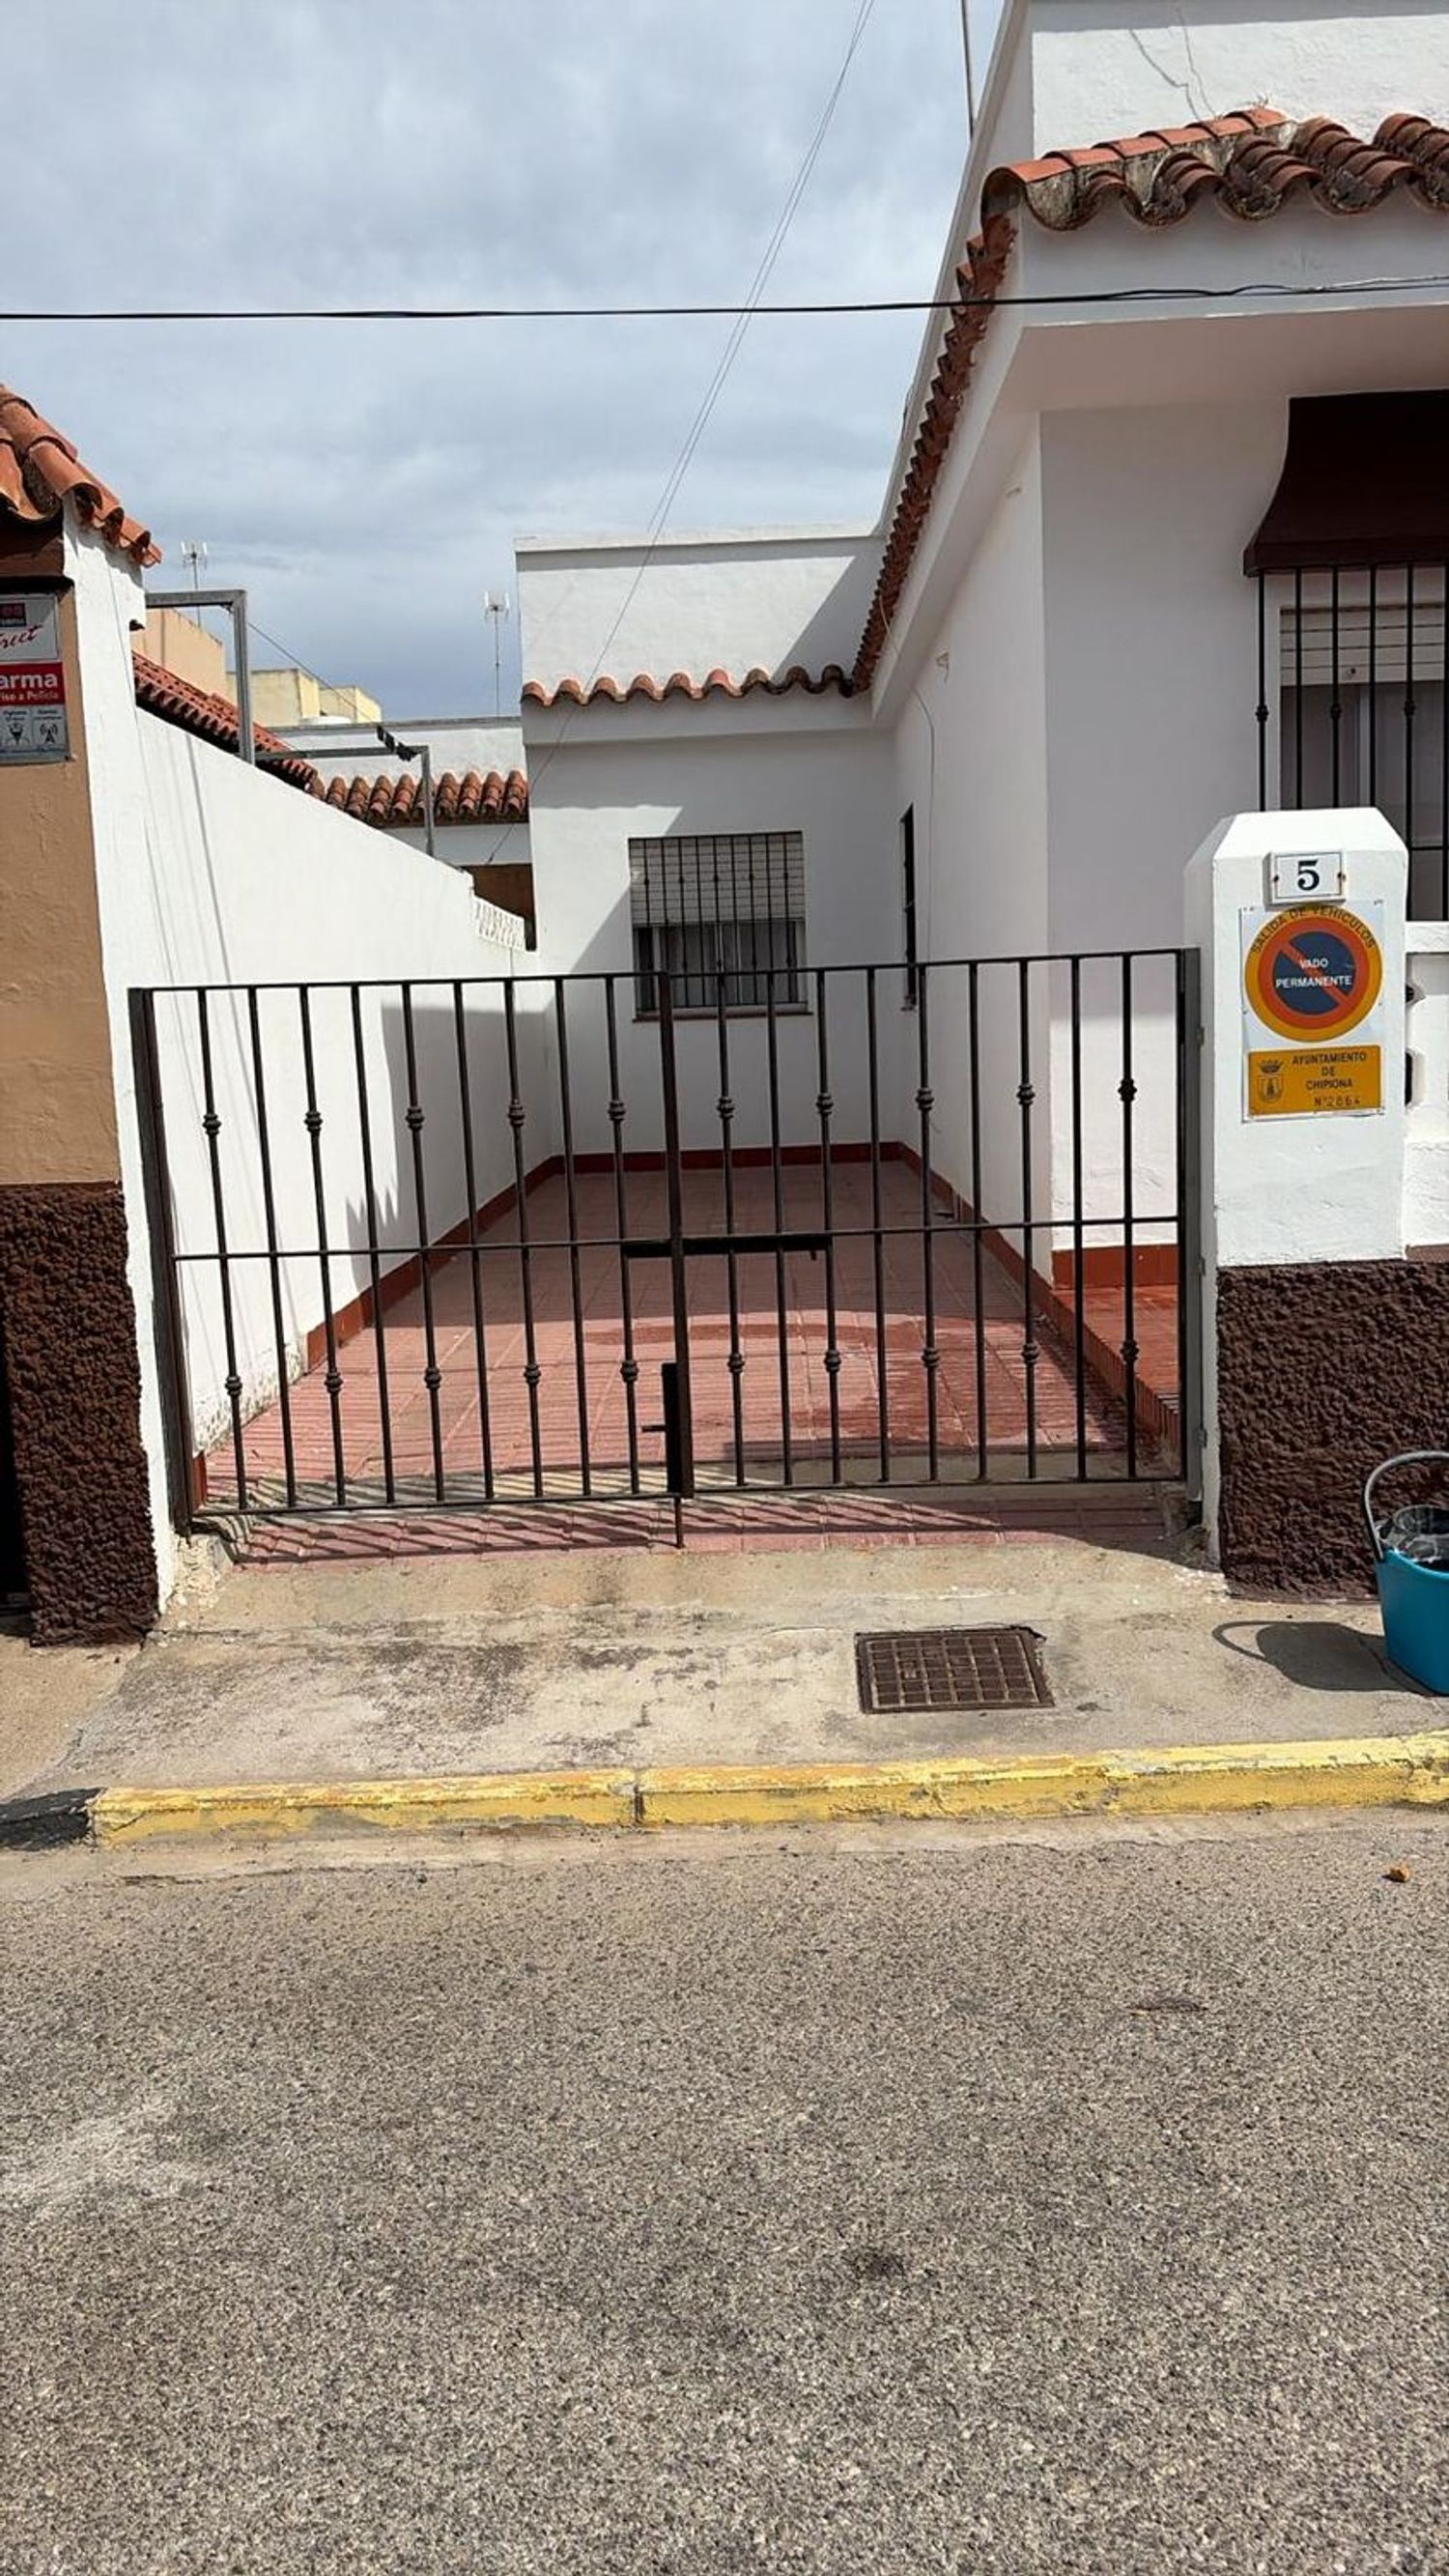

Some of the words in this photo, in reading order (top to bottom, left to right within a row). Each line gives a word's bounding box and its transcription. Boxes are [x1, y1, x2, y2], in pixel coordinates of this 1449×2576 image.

[1297, 860, 1320, 890] 5
[1250, 913, 1288, 953] SALIDA
[1289, 906, 1306, 919] DE
[1313, 904, 1376, 949] VEHICULOS
[1299, 958, 1329, 969] VADO
[1275, 975, 1352, 988] PERMANENTE
[1292, 1051, 1367, 1065] AYUNTAMIENTO
[1321, 1066, 1335, 1076] DE
[1305, 1077, 1353, 1091] CHIPIONA
